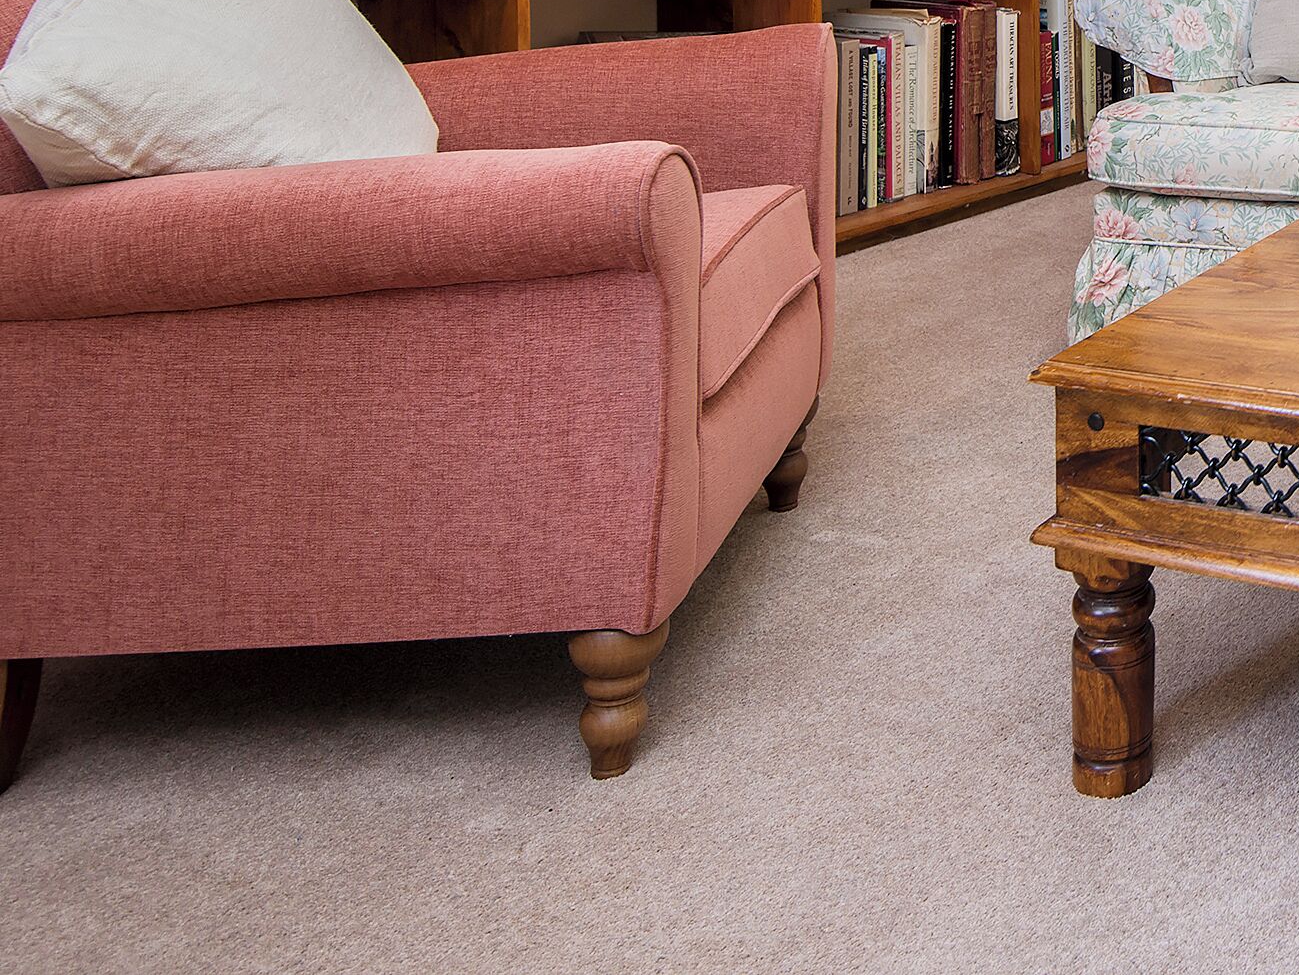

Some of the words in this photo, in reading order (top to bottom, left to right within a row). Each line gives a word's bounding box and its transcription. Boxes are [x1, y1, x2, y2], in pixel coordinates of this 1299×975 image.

[908, 61, 916, 77] The
[1045, 42, 1053, 84] FAUNA
[1089, 48, 1095, 60] OF
[908, 78, 916, 115] Romance
[1102, 71, 1112, 106] Afric
[908, 124, 916, 174] Architecture
